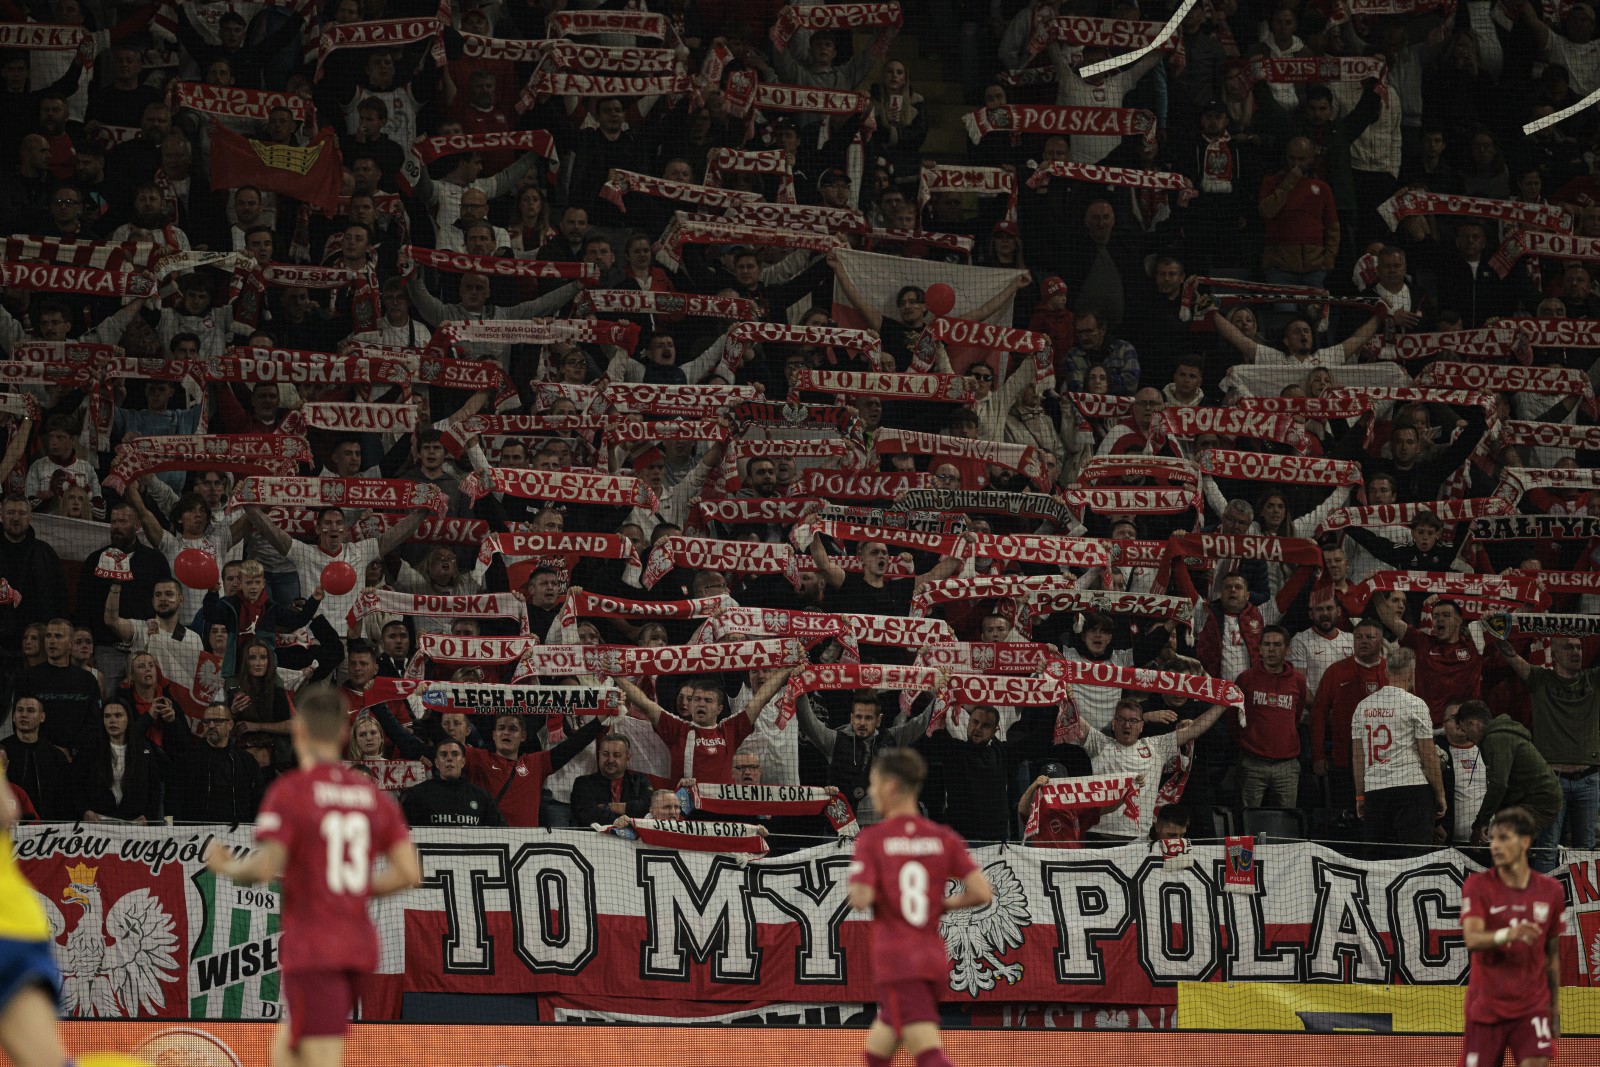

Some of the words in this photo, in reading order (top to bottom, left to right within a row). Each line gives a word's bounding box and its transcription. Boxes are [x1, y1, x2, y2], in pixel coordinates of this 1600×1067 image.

[560, 14, 658, 32] POLSKA
[558, 45, 674, 71] POLSK
[757, 87, 852, 109] POLSKA
[1025, 108, 1119, 133] POLSKA
[431, 131, 533, 153] POLSKA
[1062, 161, 1185, 189] POLSKA
[1427, 195, 1549, 225] POLSKA
[273, 268, 348, 281] POLSKA
[431, 252, 560, 277] POLSKA
[14, 264, 117, 291] POLSKA
[602, 293, 653, 310] POL
[688, 298, 739, 316] SKA
[742, 322, 865, 349] POLSKA
[935, 318, 1034, 350] POLSKA
[1396, 328, 1504, 358] OLSKA
[239, 359, 347, 383] POLSKA
[444, 366, 488, 383] SKA
[1443, 362, 1574, 393] POLSKA
[611, 385, 742, 406] POLSKA
[818, 373, 931, 396] POLSKA
[1245, 397, 1363, 412] POLSKA
[502, 415, 542, 430] POL
[566, 415, 611, 430] SKA
[618, 422, 655, 440] POL
[679, 422, 724, 440] SKA
[1178, 406, 1279, 439] POLSKA
[232, 442, 275, 456] SKA
[899, 431, 995, 462] POLSKA
[1125, 468, 1146, 477] plus
[1168, 471, 1187, 482] plus
[1221, 452, 1341, 484] POLSKA
[270, 483, 320, 498] POL
[347, 486, 399, 501] SKA
[503, 474, 625, 503] POLSKA
[809, 473, 911, 499] POLSKA
[956, 491, 1006, 508] KIELCE
[416, 520, 486, 543] OLSK
[513, 536, 608, 553] POLAND
[669, 537, 781, 572] POLSKA
[978, 535, 1108, 564] POLSKA
[1201, 535, 1284, 562] POLSKA
[97, 569, 133, 580] POLSKA
[1396, 575, 1514, 594] POLSKA
[926, 576, 1057, 602] POLSKA
[413, 594, 500, 613] POLSKA
[586, 596, 679, 617] POLAND
[1036, 593, 1088, 613] POL
[1115, 595, 1170, 617] SKA
[1457, 599, 1516, 615] POLSK
[719, 612, 764, 629] POL
[792, 616, 840, 631] SKA
[535, 652, 584, 668] POL
[634, 641, 777, 675] POLSKA
[999, 649, 1046, 664] SKA
[803, 670, 854, 686] POL
[888, 671, 936, 685] SKA
[1073, 660, 1133, 686] POL
[1158, 671, 1217, 700] SKA
[453, 688, 511, 708] LECH
[513, 686, 600, 709] POZNAŃ
[950, 675, 1067, 705] POLSKA
[1252, 690, 1271, 707] POL
[494, 706, 525, 715] HONOR
[527, 706, 575, 715] OJCZYZNA
[1364, 724, 1393, 767] 12
[717, 784, 774, 802] JELENIA
[778, 785, 815, 803] GORA
[1039, 777, 1134, 806] POLSKA
[653, 819, 710, 836] JELENIA
[713, 821, 748, 838] GORA
[12, 817, 112, 860] etrów
[120, 833, 215, 875] wspól
[236, 889, 275, 909] 1908
[898, 860, 931, 928] 8
[416, 842, 600, 977] TO
[635, 847, 876, 987] MY
[1040, 856, 1475, 987] POLAC
[197, 937, 280, 993] WISŁ
[1530, 1016, 1551, 1039] 14
